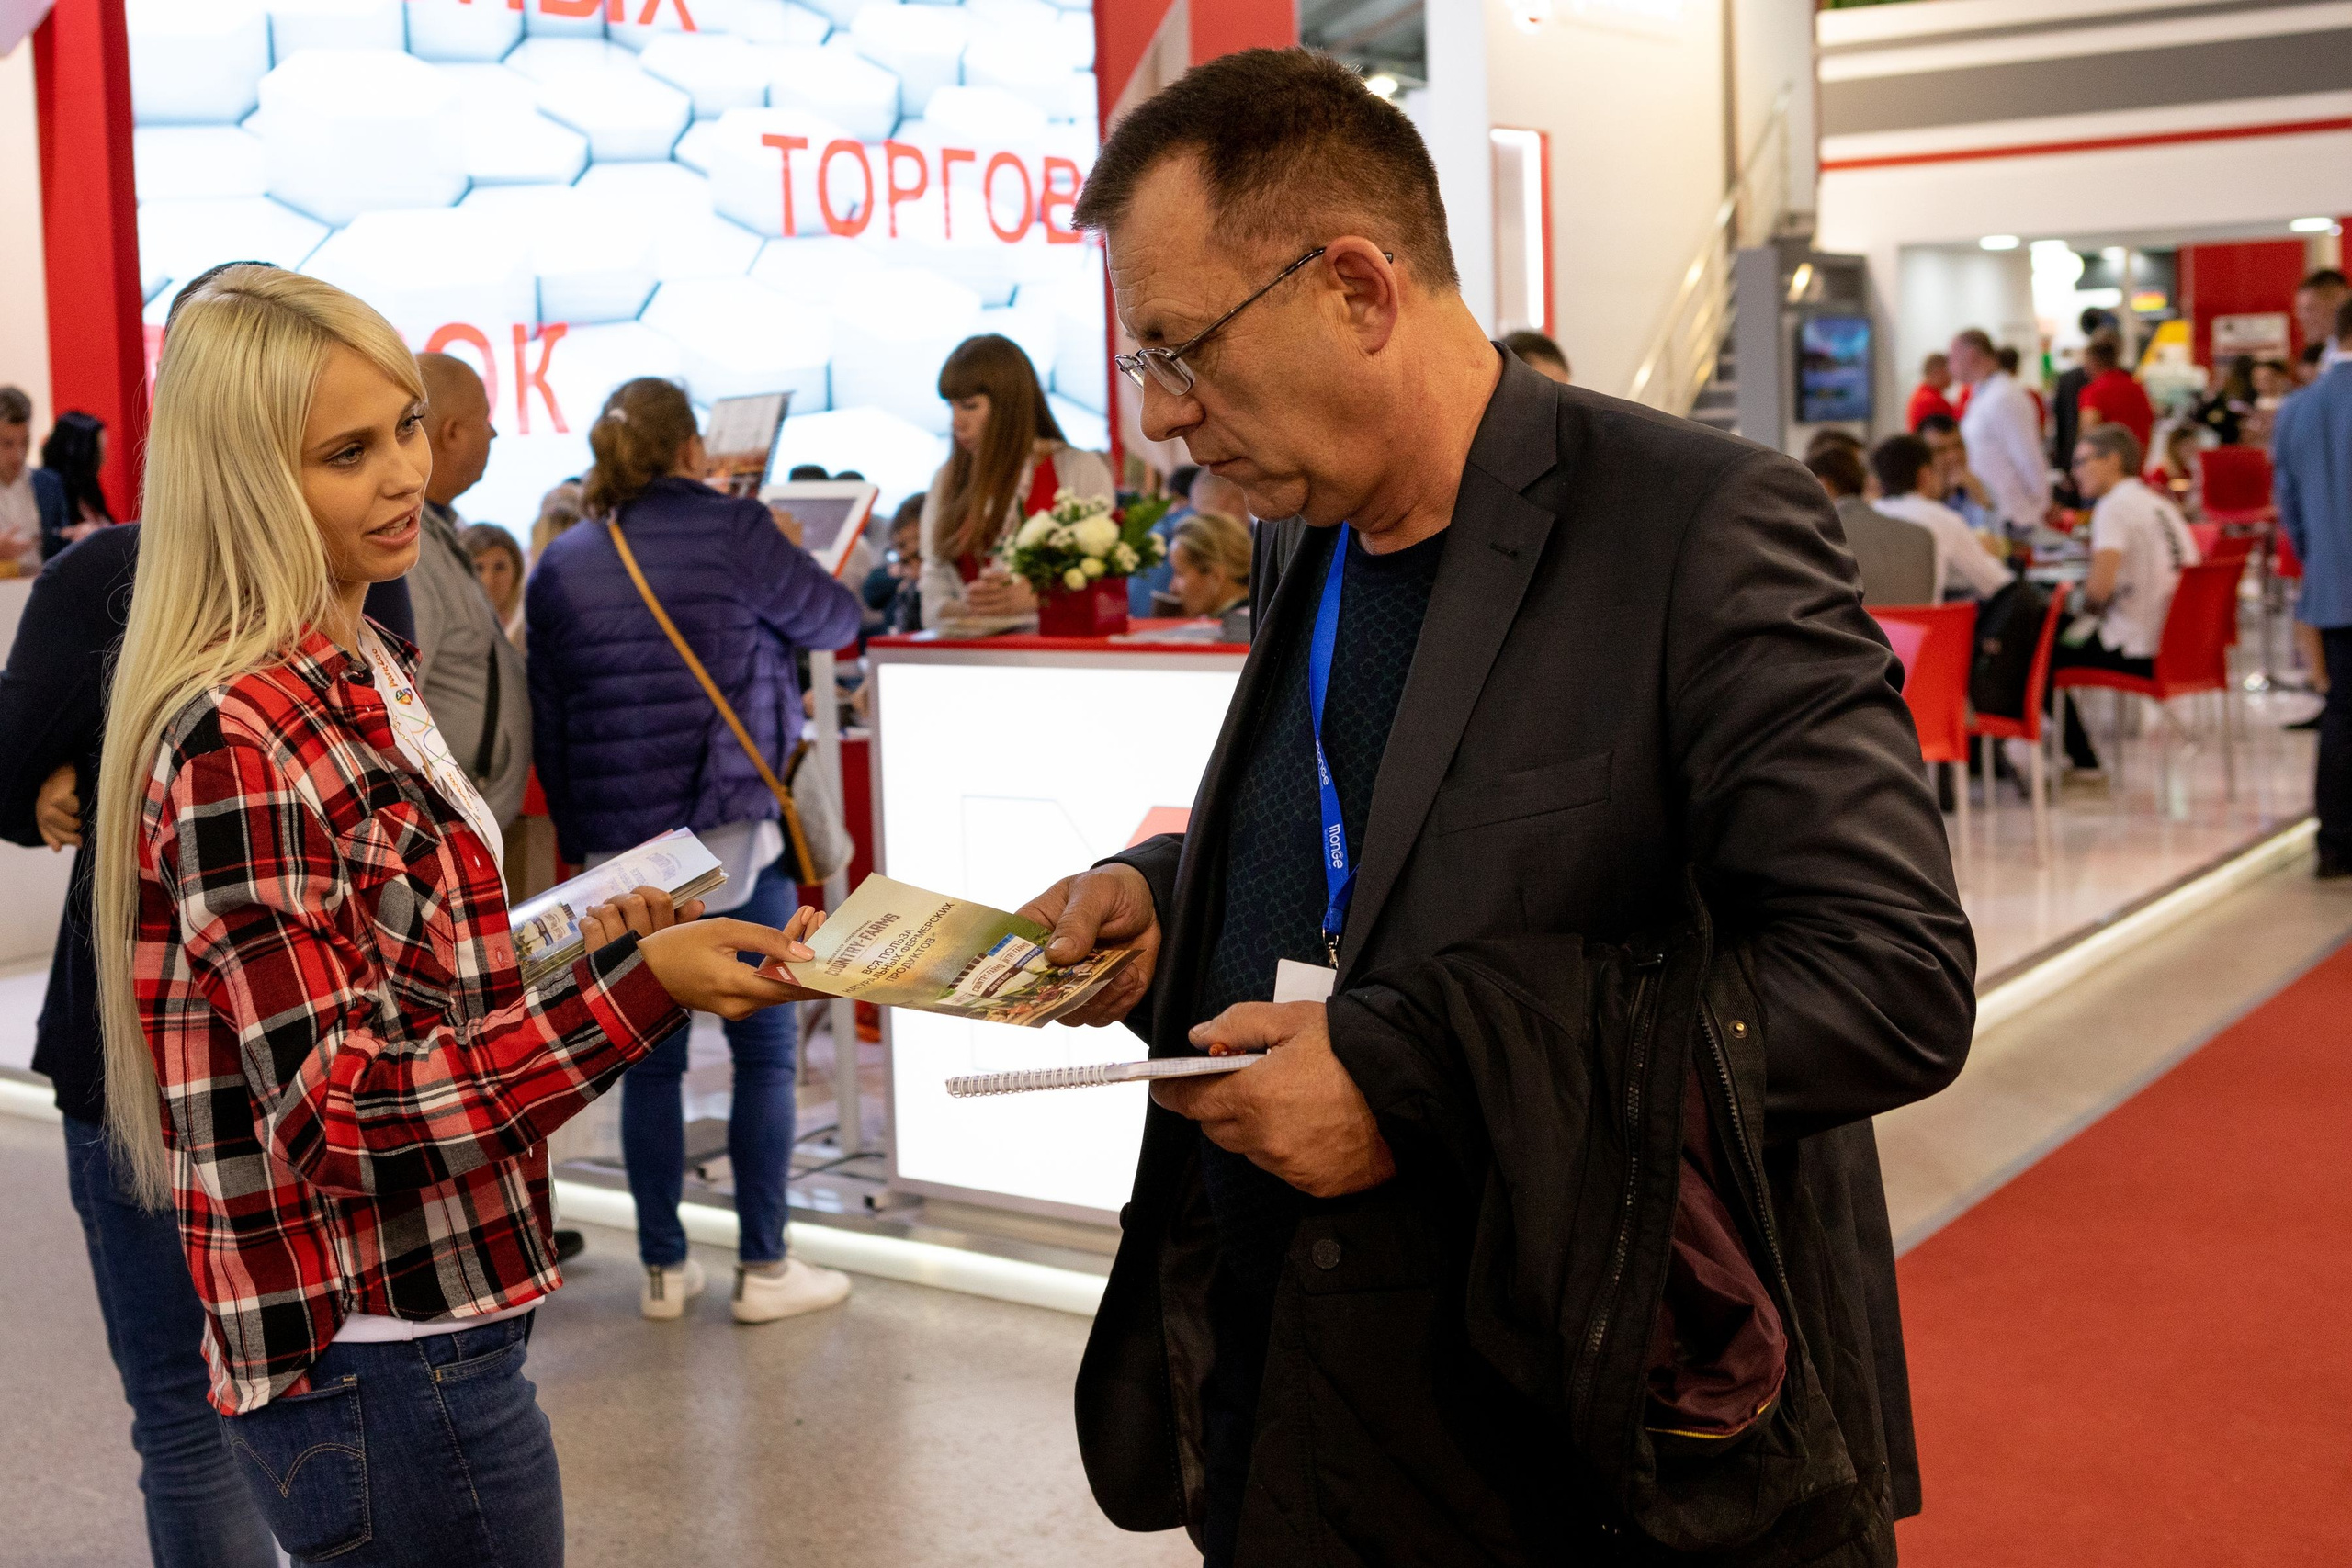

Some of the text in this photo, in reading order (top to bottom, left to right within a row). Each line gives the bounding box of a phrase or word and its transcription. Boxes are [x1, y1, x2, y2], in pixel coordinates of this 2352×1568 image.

[824, 912, 901, 976] COUNTRY-FARMS
[842, 902, 956, 994] НАТУРАЛЬНЫХ ФЕРМЕРСКИХ
[862, 928, 915, 975] ВСЯ ПОЛЬЗА
[885, 937, 936, 982] ПРОДУКТОВ
